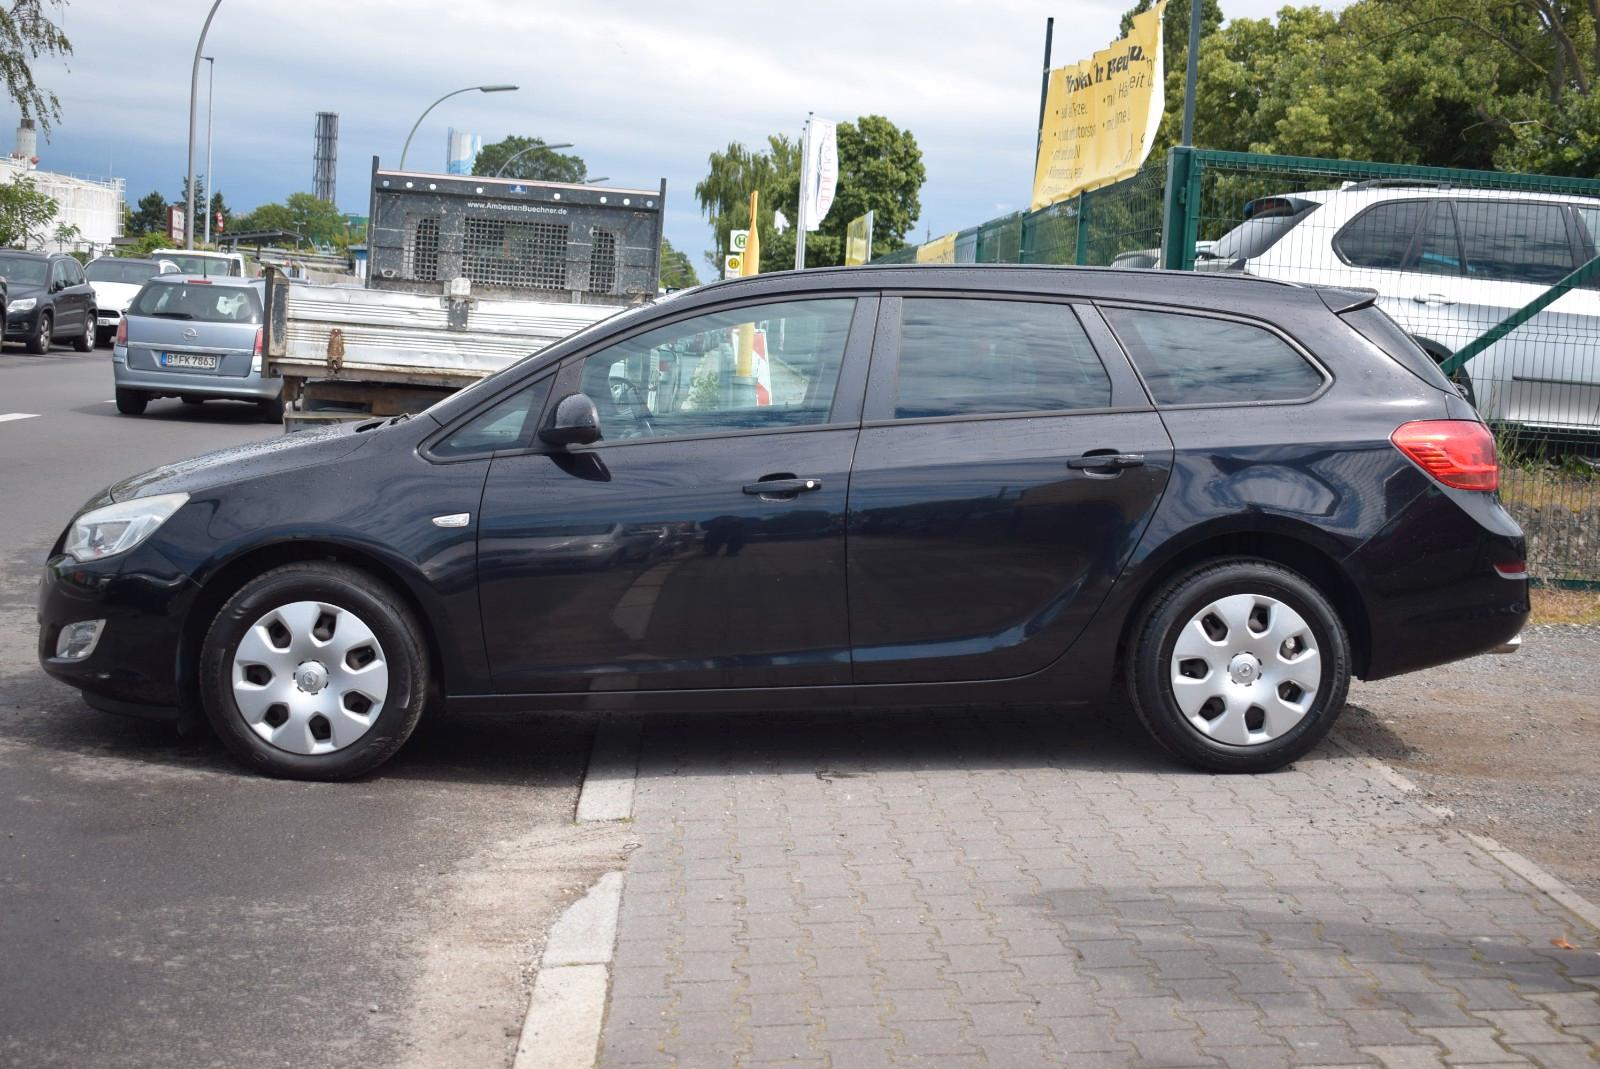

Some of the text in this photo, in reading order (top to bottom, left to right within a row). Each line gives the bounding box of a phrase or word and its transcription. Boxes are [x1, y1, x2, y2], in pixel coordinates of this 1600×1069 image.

[467, 201, 567, 215] www.AmbestenBuechner.de
[167, 354, 215, 367] B FK 7863
